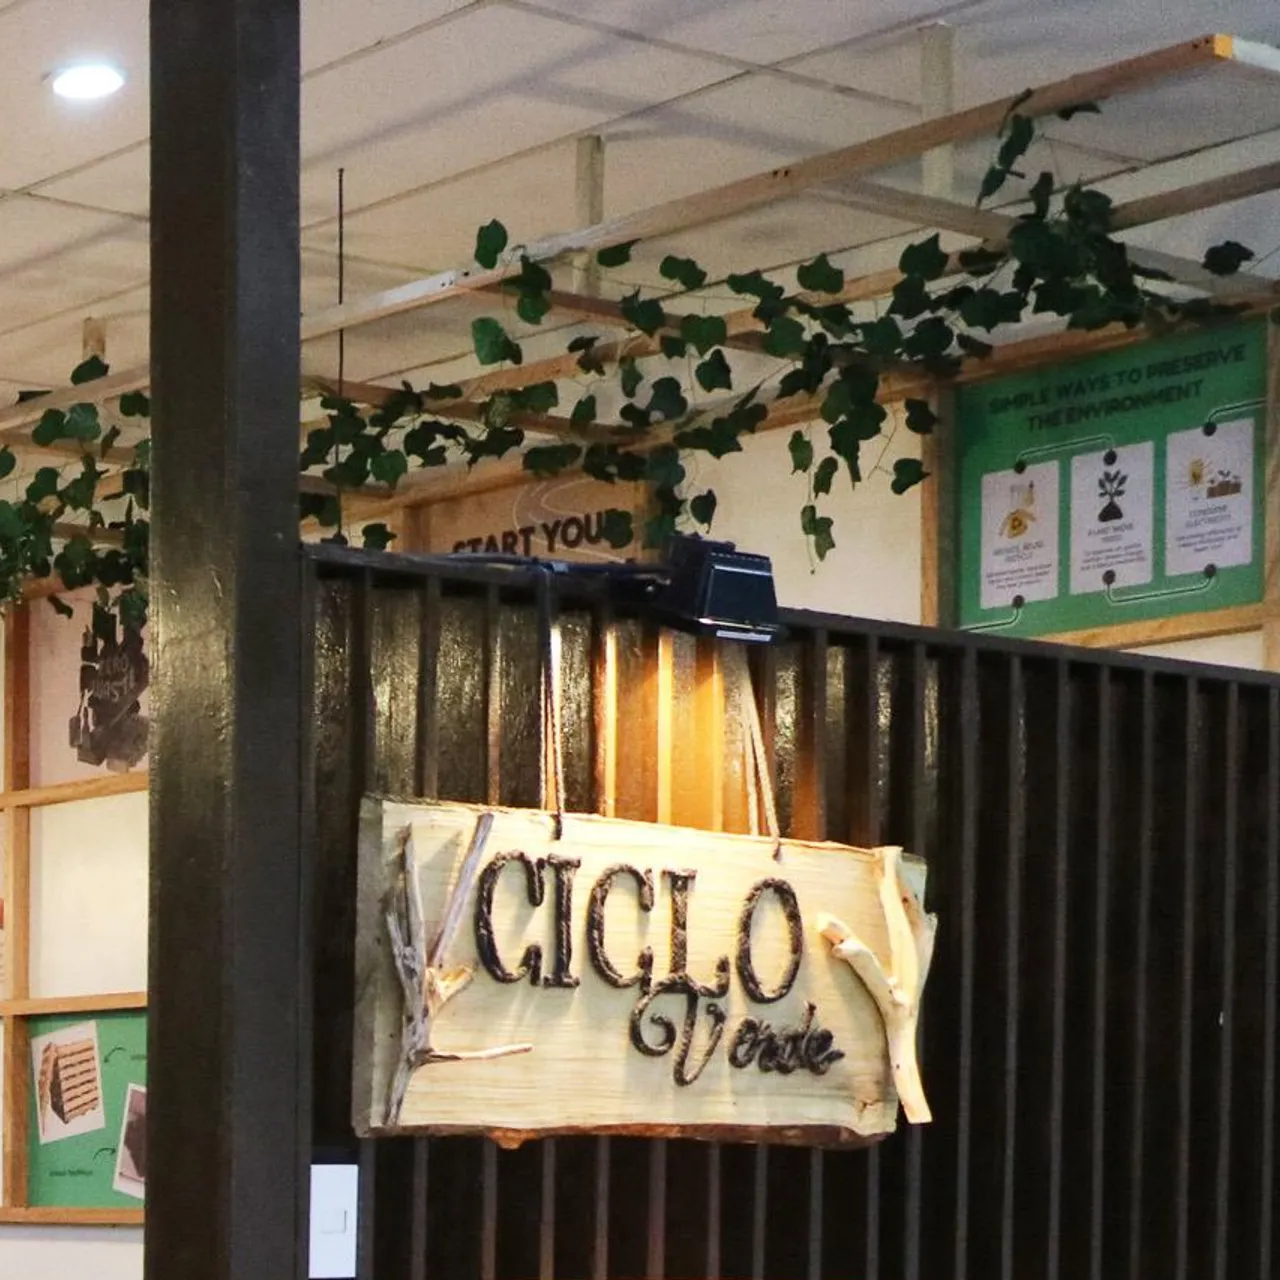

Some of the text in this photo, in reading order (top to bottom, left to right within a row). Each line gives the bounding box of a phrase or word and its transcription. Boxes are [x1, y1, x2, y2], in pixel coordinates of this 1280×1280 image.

[1056, 373, 1112, 398] WAYS
[1114, 368, 1142, 387] TO
[1147, 345, 1245, 379] PRESERVE
[1028, 379, 1205, 432] THE ENVIRONMENT
[541, 510, 605, 552] YOU
[474, 849, 804, 1004] CICLO
